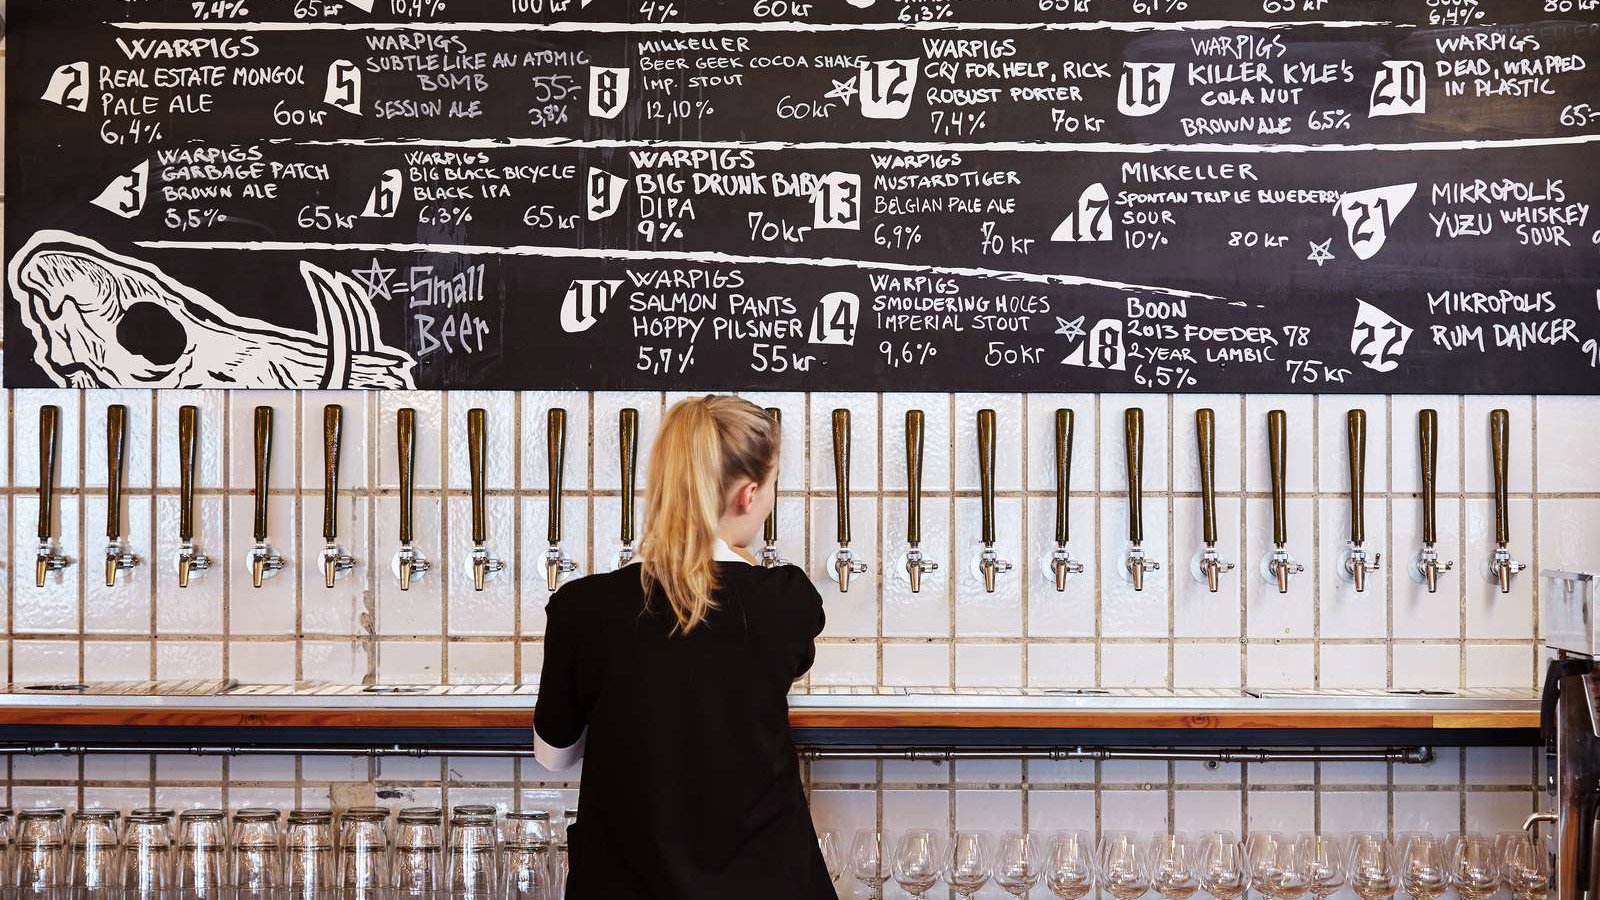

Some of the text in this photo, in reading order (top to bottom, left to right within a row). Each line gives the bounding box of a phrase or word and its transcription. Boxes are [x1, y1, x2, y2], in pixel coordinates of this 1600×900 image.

[639, 1, 678, 22] 4%
[897, 5, 953, 22] 6,3%
[115, 35, 260, 61] WARPIGS
[365, 33, 468, 54] WARPIGS
[637, 36, 751, 56] MIKKELLER
[921, 37, 1017, 60] WARPIGS
[1190, 34, 1288, 60] WARPIGS
[1435, 33, 1542, 54] WARPIGS
[366, 50, 590, 73] SUBTLE LIKE AN ATOMIC
[638, 57, 691, 72] BEER
[695, 56, 745, 70] GEEK
[749, 55, 809, 70] COCOA
[923, 60, 1112, 85] CRY FOR HELP, RICK
[1435, 54, 1587, 80] DEAD, WRAPPED
[98, 64, 305, 90] REAL ESTATE MONGOL
[416, 73, 490, 92] BOMB
[687, 73, 744, 90] STOUT
[1187, 62, 1275, 87] KILLER
[926, 86, 1083, 106] ROBUST PORTER
[1200, 87, 1304, 107] COLA NUT
[1444, 77, 1556, 98] IN PLASTIC
[101, 95, 214, 117] PALE ALE
[374, 99, 483, 120] SESSION ALE
[527, 104, 569, 128] 3,8%
[645, 99, 715, 125] 12,10%
[100, 119, 163, 145] 6,4%
[930, 109, 987, 137] 7,4%
[1180, 115, 1254, 139] BROWN
[157, 145, 264, 167] WARPIGS
[404, 150, 491, 166] WARPIGS
[629, 149, 756, 171] WARPIGS
[870, 152, 963, 170] WARPIGS
[161, 161, 330, 184] GARBAGE PATCH
[409, 165, 577, 184] BIG BLACK BICYCLE
[873, 171, 1022, 191] MUSTARD TIGER
[1121, 161, 1259, 184] MIKKELLER
[163, 183, 279, 203] BROWN ALE
[413, 184, 512, 201] BLACK IPA
[635, 172, 826, 204] BIG DRUNK BABY
[1114, 190, 1189, 208] SPONTAN
[1190, 190, 1252, 204] TRIPLE
[1431, 178, 1566, 206] MIKROPOLIS
[639, 195, 697, 221] DIPA
[947, 197, 982, 213] PALE
[986, 197, 1016, 214] ALE
[418, 207, 473, 227] 6,3%
[1121, 210, 1177, 226] SOUR
[1428, 202, 1590, 239] YUZU WHISKEY
[637, 219, 684, 243] 9%
[873, 223, 922, 250] 6,9%
[1125, 230, 1169, 250] 10%
[1515, 224, 1572, 247] SOUR
[626, 269, 745, 289] WARPIGS
[869, 274, 960, 295] WARPIGS
[629, 292, 797, 315] SALMON PANTS
[872, 295, 1050, 314] SMOLDERING HOLES
[1126, 297, 1188, 319] BOON
[1427, 289, 1557, 315] MIKROPOLIS
[633, 315, 804, 344] HOPPY PILSNER
[877, 312, 1031, 332] IMPERIAL STOUT
[1127, 320, 1311, 347] 2013 FOEDER 78
[1430, 318, 1580, 353] RUM DANCER
[636, 344, 695, 375] 5,7%
[879, 340, 938, 368] 9,6%
[1145, 345, 1198, 364] YEAR
[1206, 344, 1277, 363] LAMBIC
[1133, 364, 1198, 388] 6,5%
